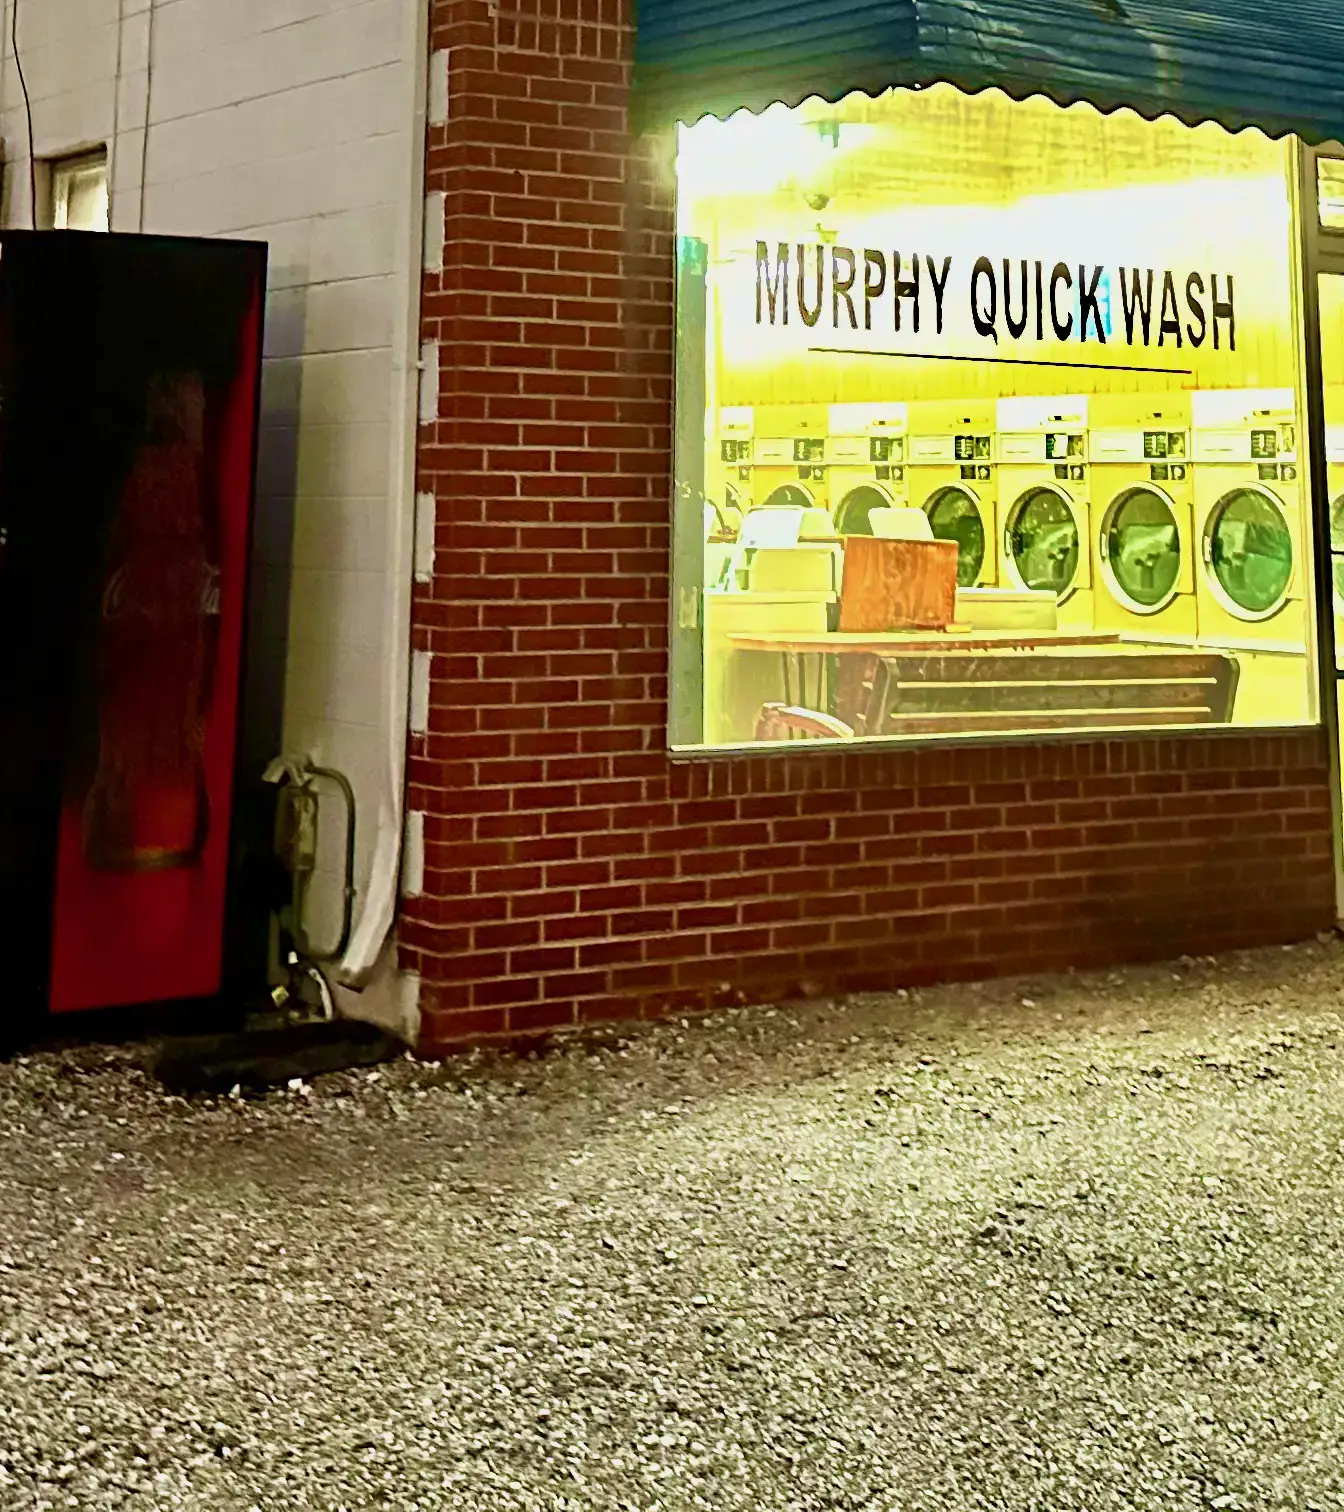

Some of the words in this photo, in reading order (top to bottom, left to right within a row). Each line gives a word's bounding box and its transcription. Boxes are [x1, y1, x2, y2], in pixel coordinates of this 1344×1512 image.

[755, 239, 952, 335] MURPHY
[969, 255, 1107, 346] QUICK
[1119, 266, 1236, 352] WASH
